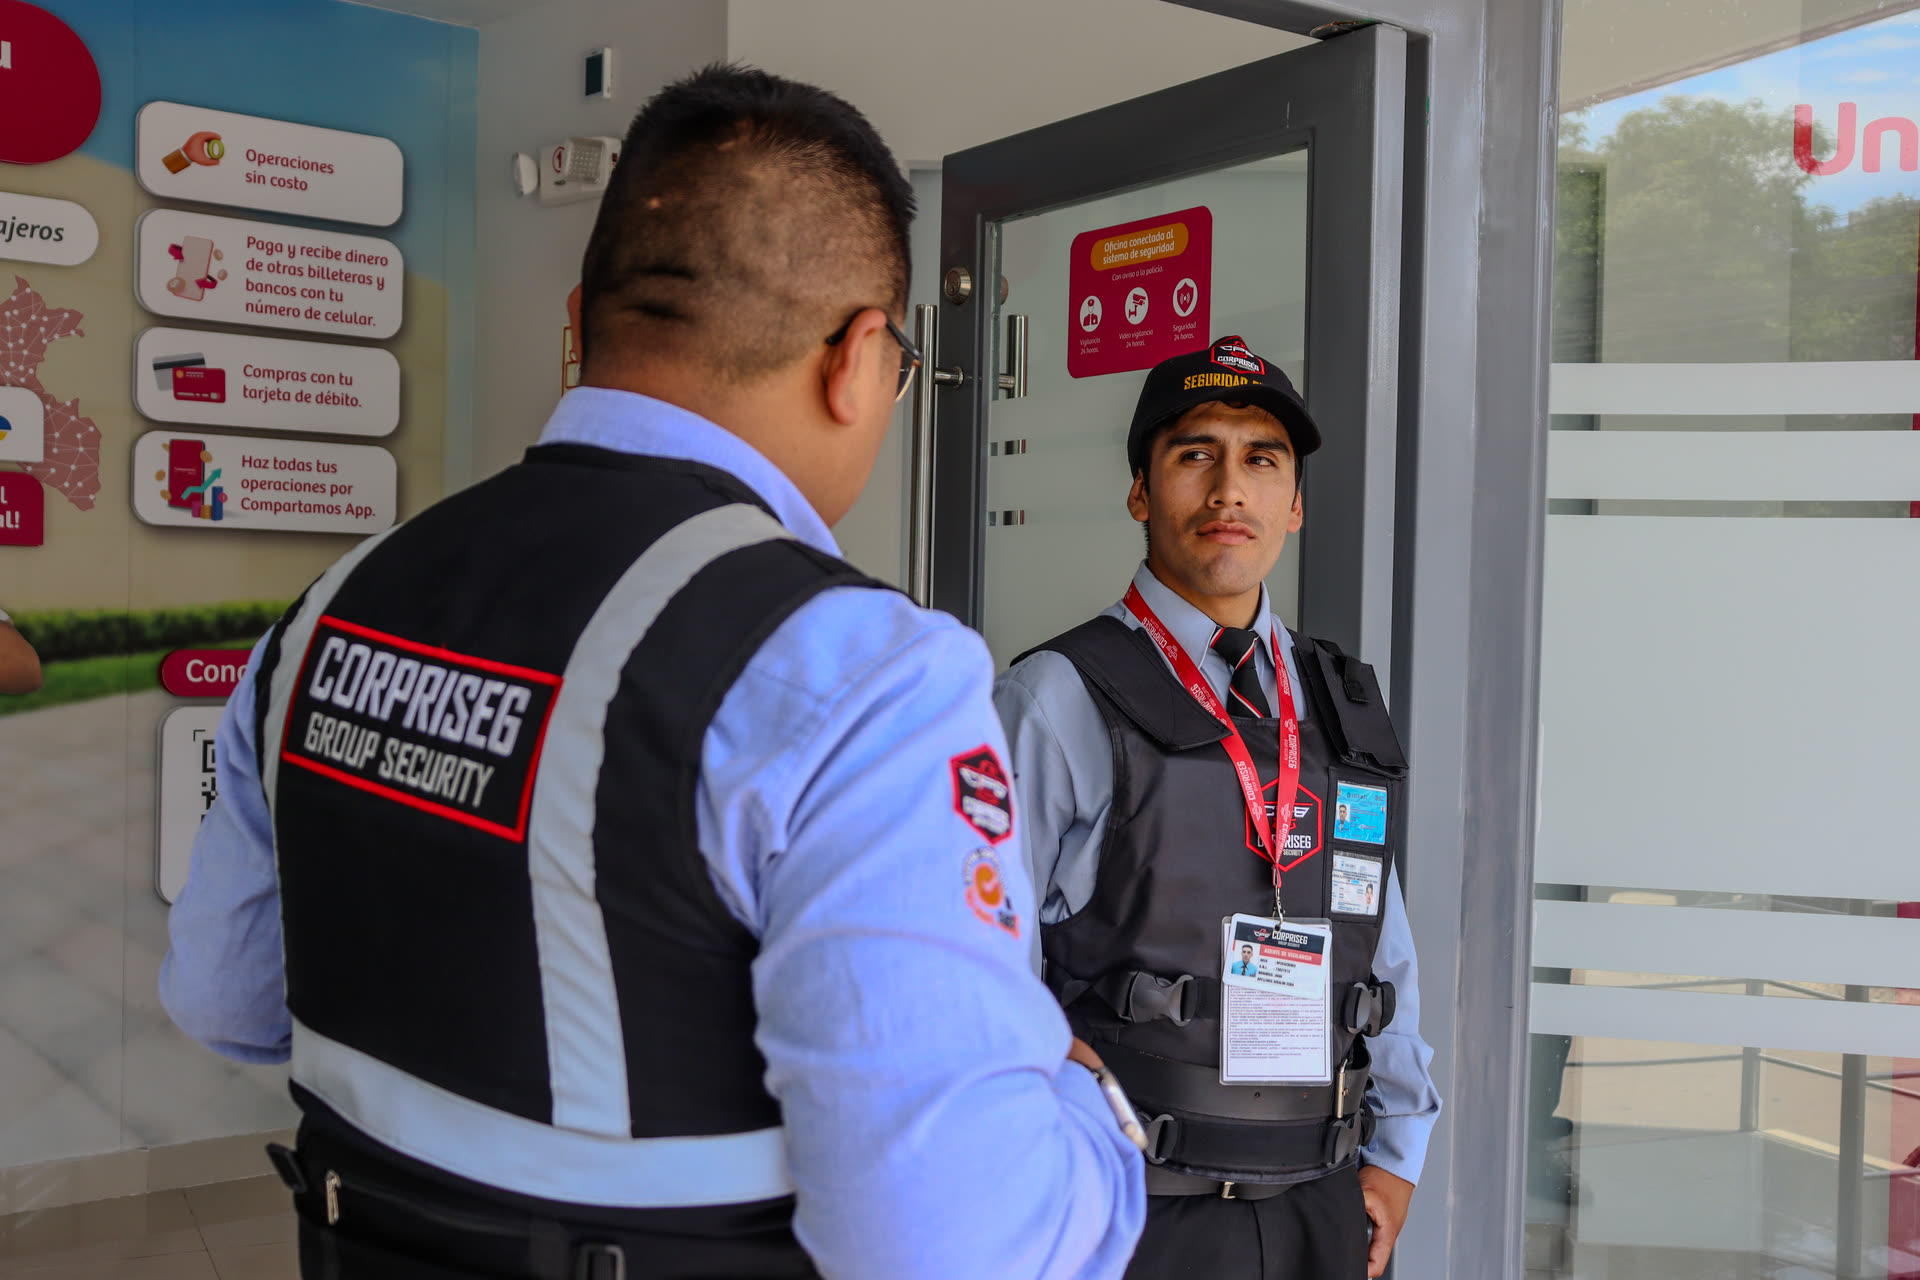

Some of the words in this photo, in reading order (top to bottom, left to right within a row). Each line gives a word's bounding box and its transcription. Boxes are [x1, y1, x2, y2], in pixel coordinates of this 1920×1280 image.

[1794, 102, 1919, 176] Un
[245, 149, 335, 174] Operaciones
[245, 170, 266, 185] sin
[270, 176, 308, 191] costo
[246, 236, 283, 256] Paga
[287, 244, 296, 259] y
[300, 245, 342, 260] recibe
[345, 250, 389, 267] dinero
[1103, 252, 1129, 265] sistema
[1130, 249, 1139, 259] de
[1140, 240, 1175, 259] seguridad
[1104, 240, 1128, 254] Oficina
[1129, 232, 1165, 247] conectada
[1166, 228, 1174, 240] al
[246, 258, 263, 272] de
[267, 261, 304, 277] otras
[308, 265, 373, 285] billeteras
[376, 276, 385, 291] y
[1112, 273, 1121, 281] Con
[245, 278, 297, 296] bancos
[300, 287, 325, 300] con
[329, 288, 344, 302] tu
[245, 299, 300, 318] número
[304, 306, 321, 320] de
[325, 310, 376, 327] celular.
[1173, 322, 1197, 333] Seguridad
[243, 364, 307, 383] Compras
[310, 372, 335, 385] con
[339, 371, 353, 386] tu
[243, 384, 291, 403] tarjeta
[294, 389, 312, 403] de
[315, 390, 362, 408] débito.
[242, 455, 270, 470] Haz
[273, 456, 313, 472] todas
[316, 459, 338, 474] tus
[240, 478, 326, 495] operaciones
[330, 482, 354, 497] por
[240, 497, 342, 516] Compartamos
[345, 503, 376, 519] App.
[309, 636, 532, 757] CORPRISEG
[304, 711, 381, 769] GROUP
[377, 736, 495, 808] SECURITY
[1288, 734, 1297, 770] CORPRISEG
[1236, 761, 1256, 801] CORPRISEG
[1271, 930, 1308, 945] CORPRISEG
